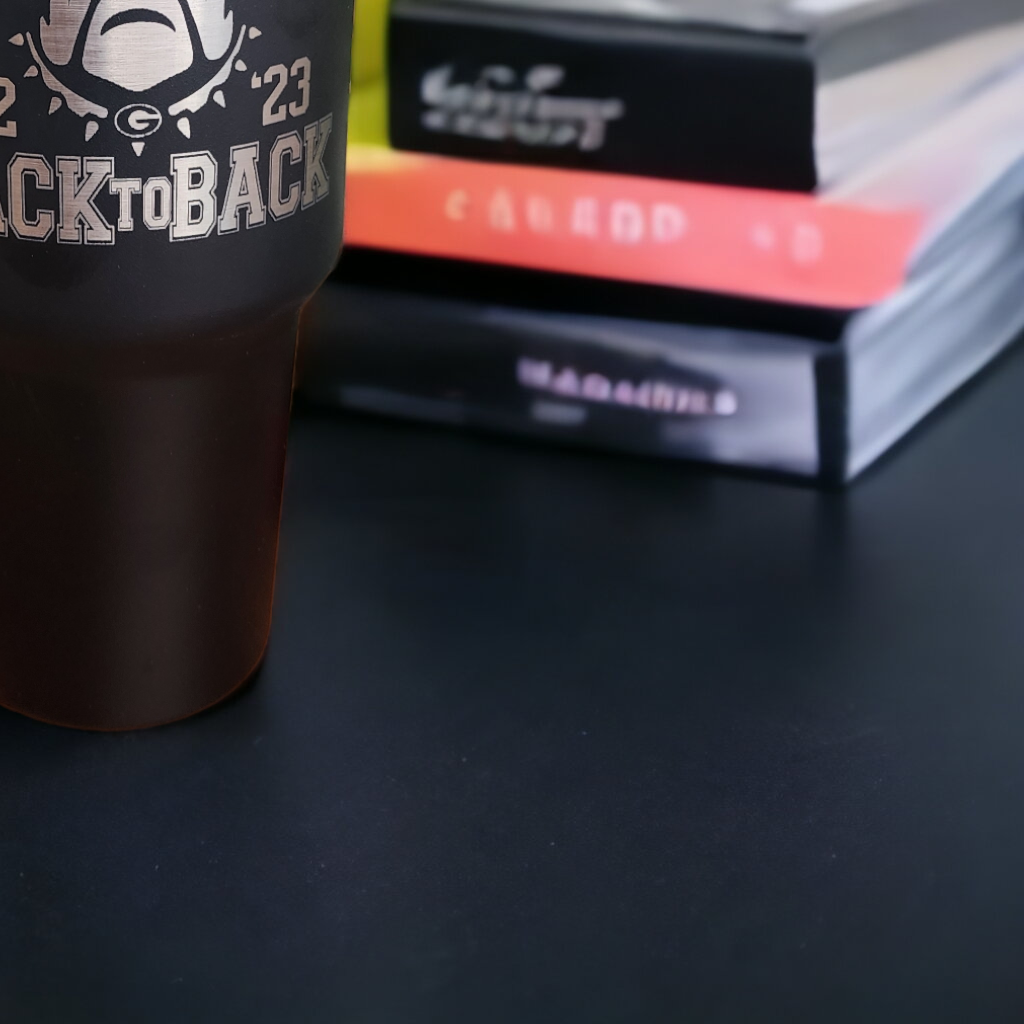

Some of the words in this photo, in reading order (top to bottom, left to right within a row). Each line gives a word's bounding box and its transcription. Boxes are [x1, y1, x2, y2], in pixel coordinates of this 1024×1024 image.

[115, 104, 162, 137] G
[110, 176, 172, 232] TO
[169, 112, 333, 243] BACK
